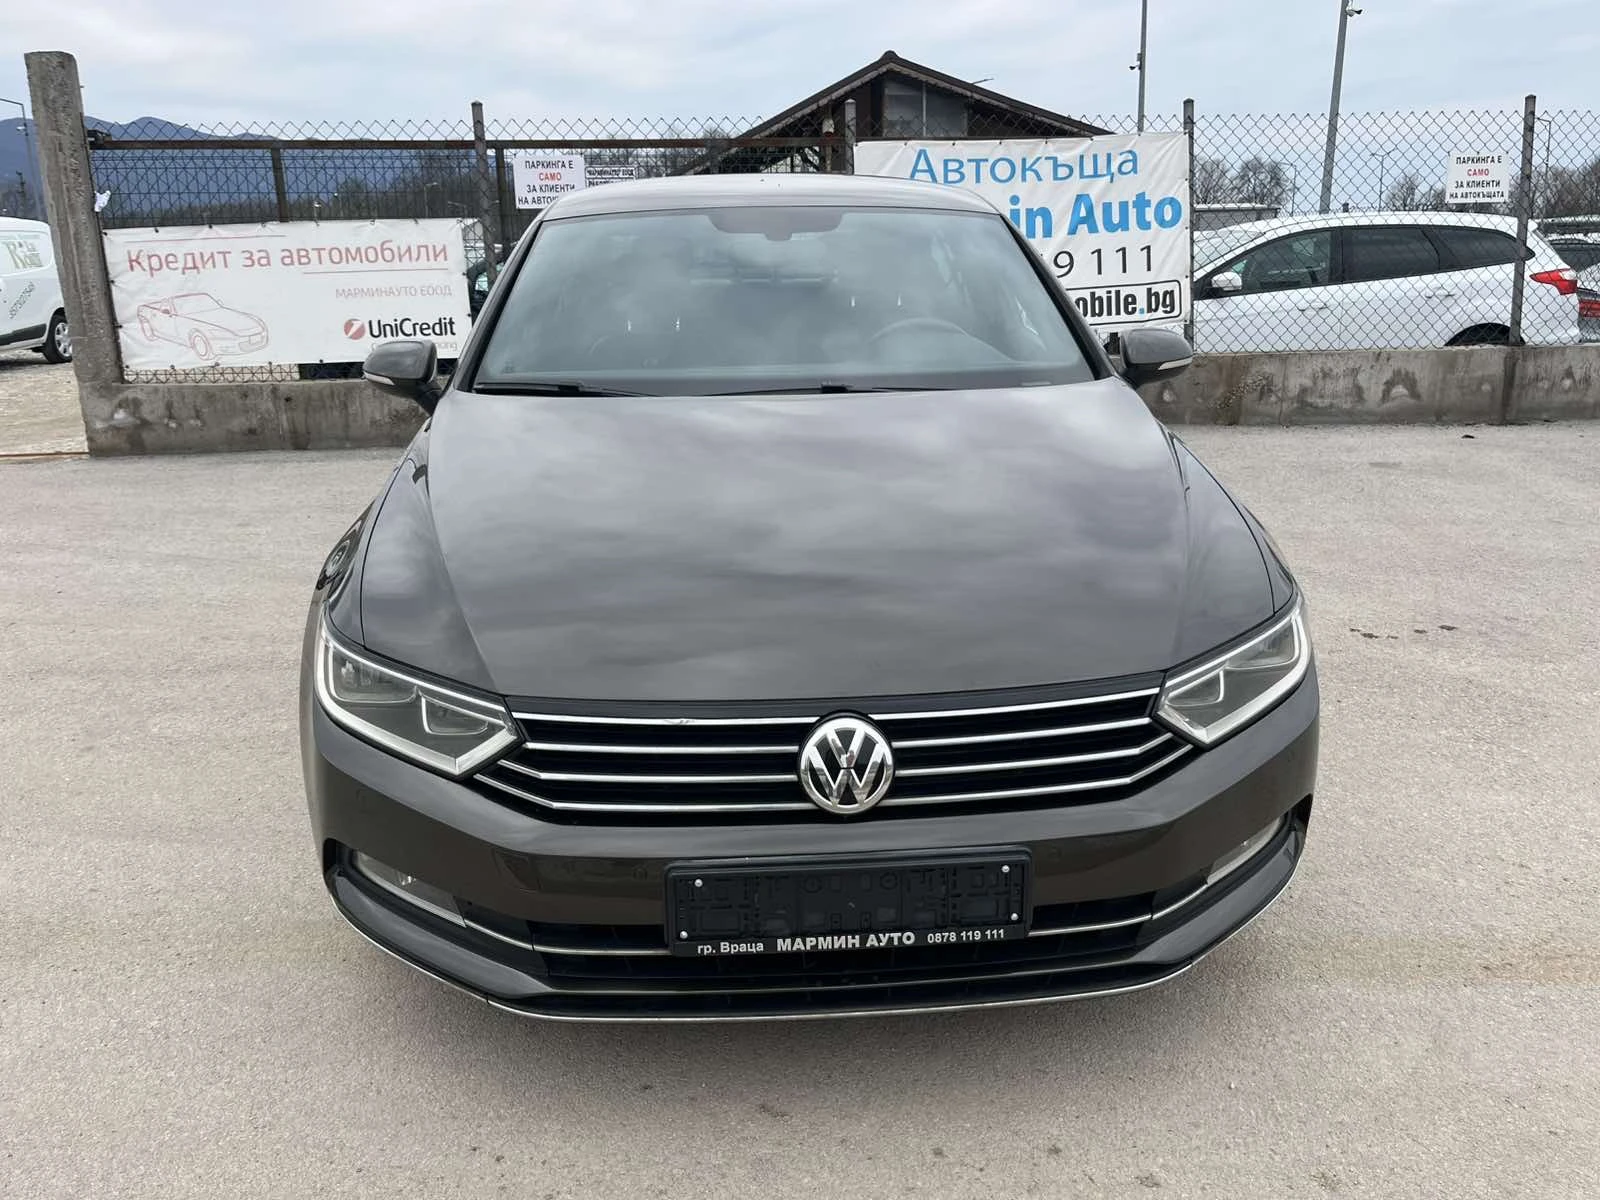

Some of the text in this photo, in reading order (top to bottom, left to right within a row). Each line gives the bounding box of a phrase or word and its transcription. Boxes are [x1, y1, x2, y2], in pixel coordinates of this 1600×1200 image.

[525, 160, 574, 169] ПАРКИНГА Е
[1456, 155, 1502, 164] ПАРКИНГА Е
[910, 148, 1138, 184] Автокъща
[539, 172, 562, 181] САМО
[526, 184, 575, 193] ЗА КЛИЕНТИ
[1455, 180, 1500, 188] ЗА КЛИЕНТИ
[1460, 191, 1504, 199] АВТОКЪЩАТА
[518, 196, 558, 205] НА АВТО
[1009, 192, 1183, 239] in Auto
[127, 240, 448, 277] Кредит за автомобили
[335, 286, 417, 298] МАРМИНАУТО
[1075, 288, 1176, 318] obile.bg
[368, 317, 456, 338] UniCredit
[697, 928, 1004, 955] гр. Враца МАРМИН АУТО 0878 119 111
